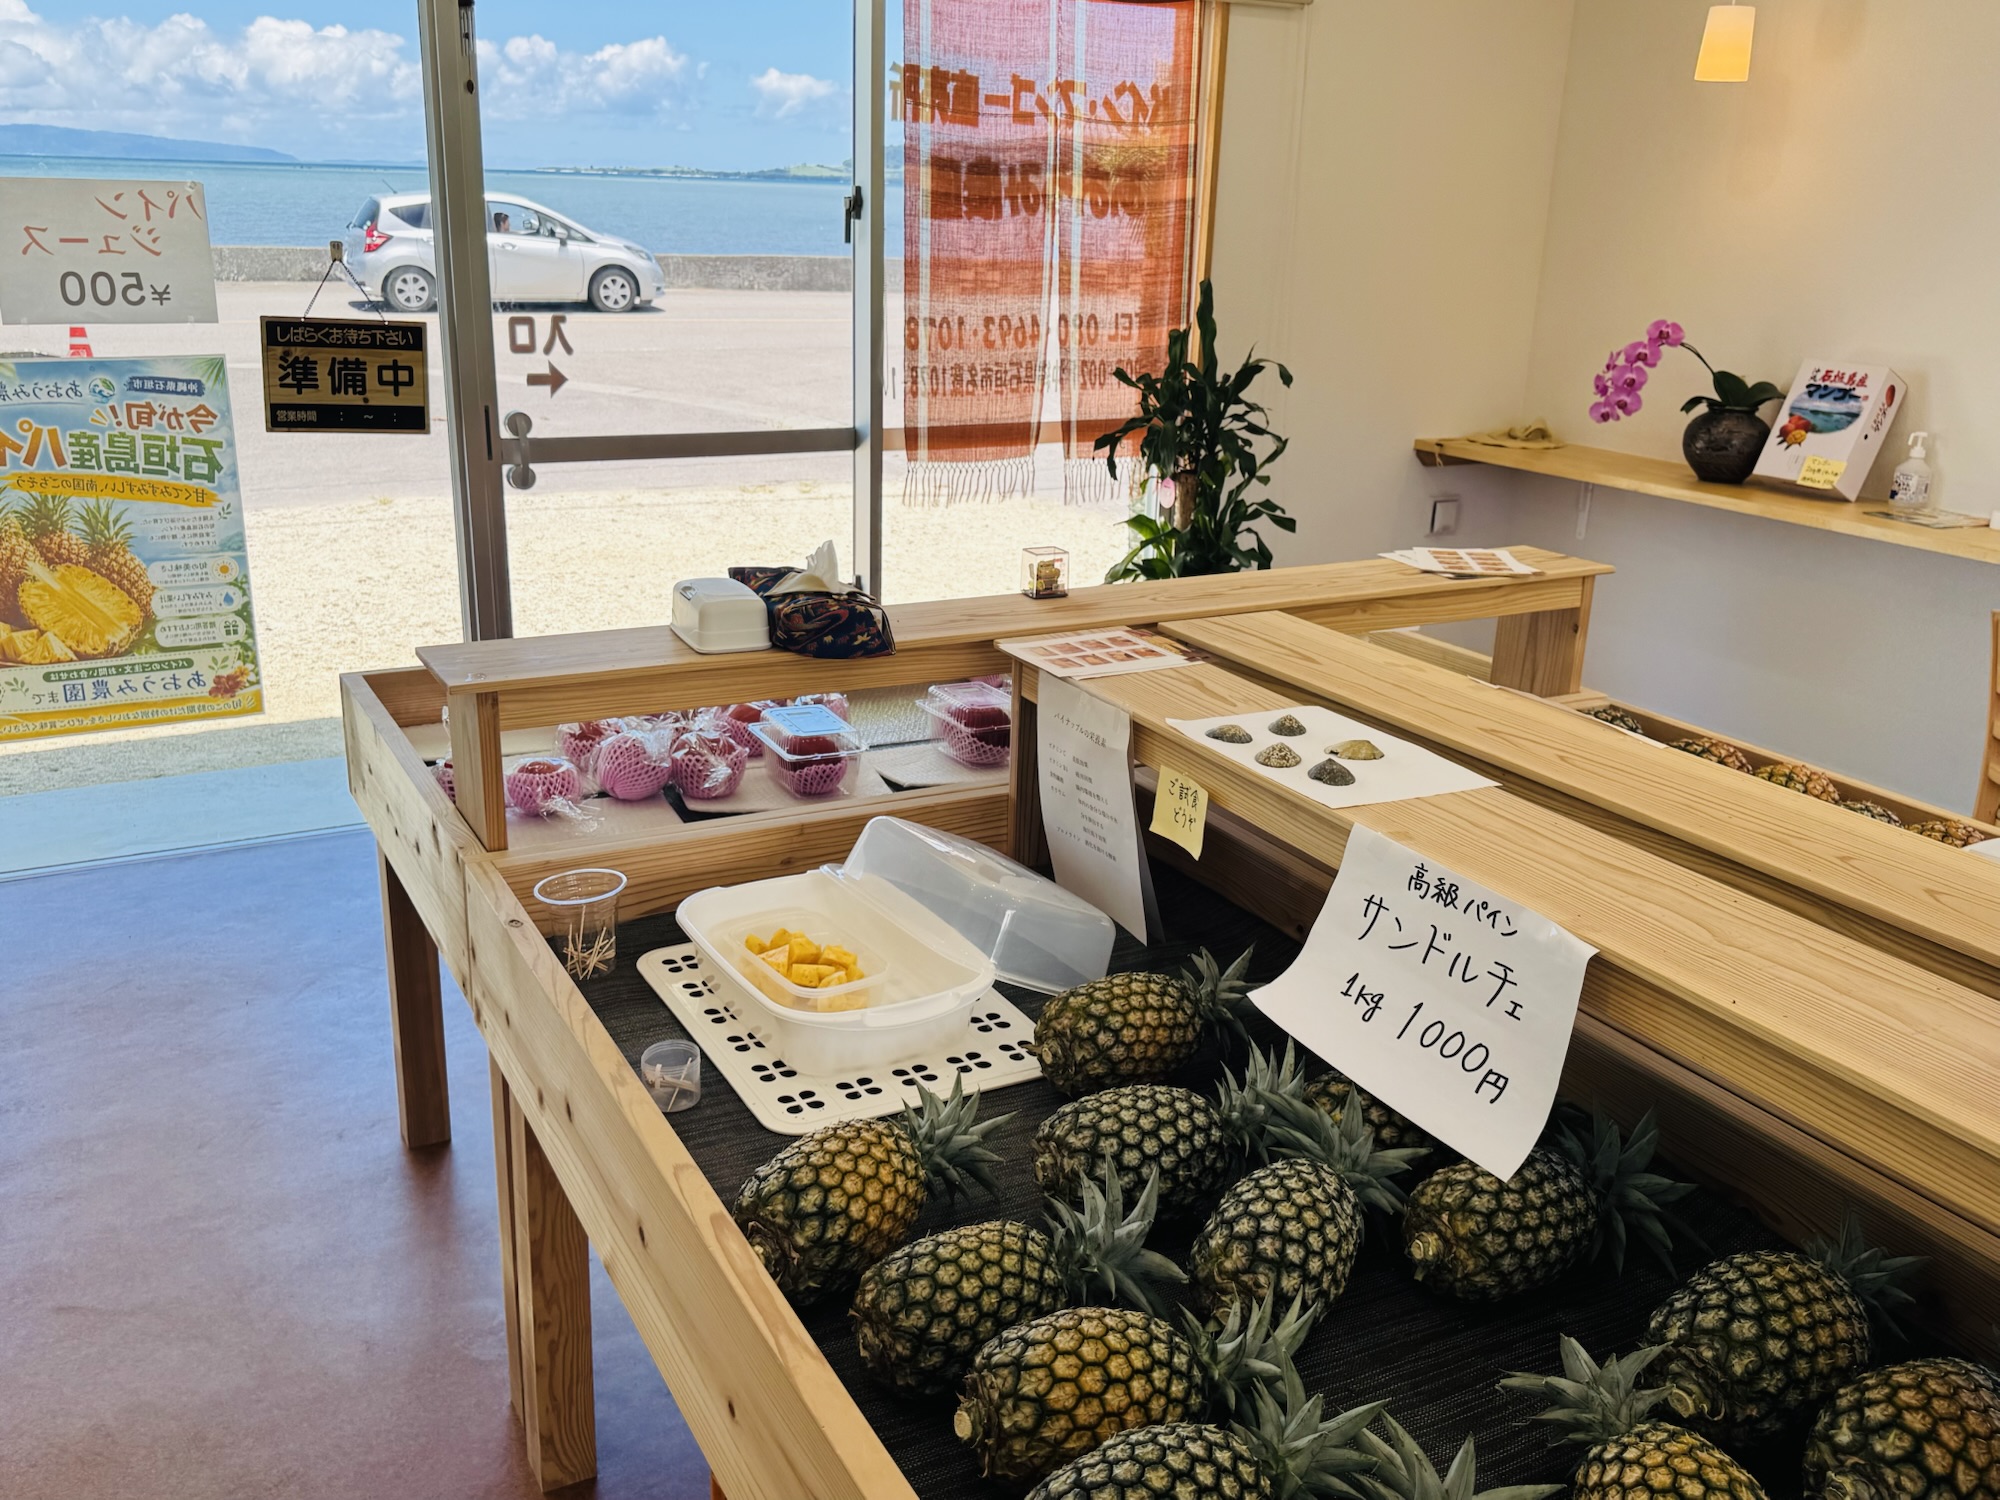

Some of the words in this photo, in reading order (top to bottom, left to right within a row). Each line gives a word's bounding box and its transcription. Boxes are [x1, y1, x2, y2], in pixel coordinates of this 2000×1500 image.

[276, 325, 414, 346] しばらくお待ち下さい
[277, 354, 416, 398] 準備中
[1805, 383, 1862, 402] マンゴー
[276, 409, 318, 423] 営業時間
[1053, 711, 1108, 749] パイナップルの栄養素
[1168, 777, 1201, 812] ご試食
[1173, 806, 1198, 833] どうぞ
[1407, 862, 1519, 938] 高級パイン
[1357, 893, 1524, 1022] サンドルチェ
[1339, 971, 1386, 1023] 1kg
[1395, 1000, 1510, 1105] 1000円
